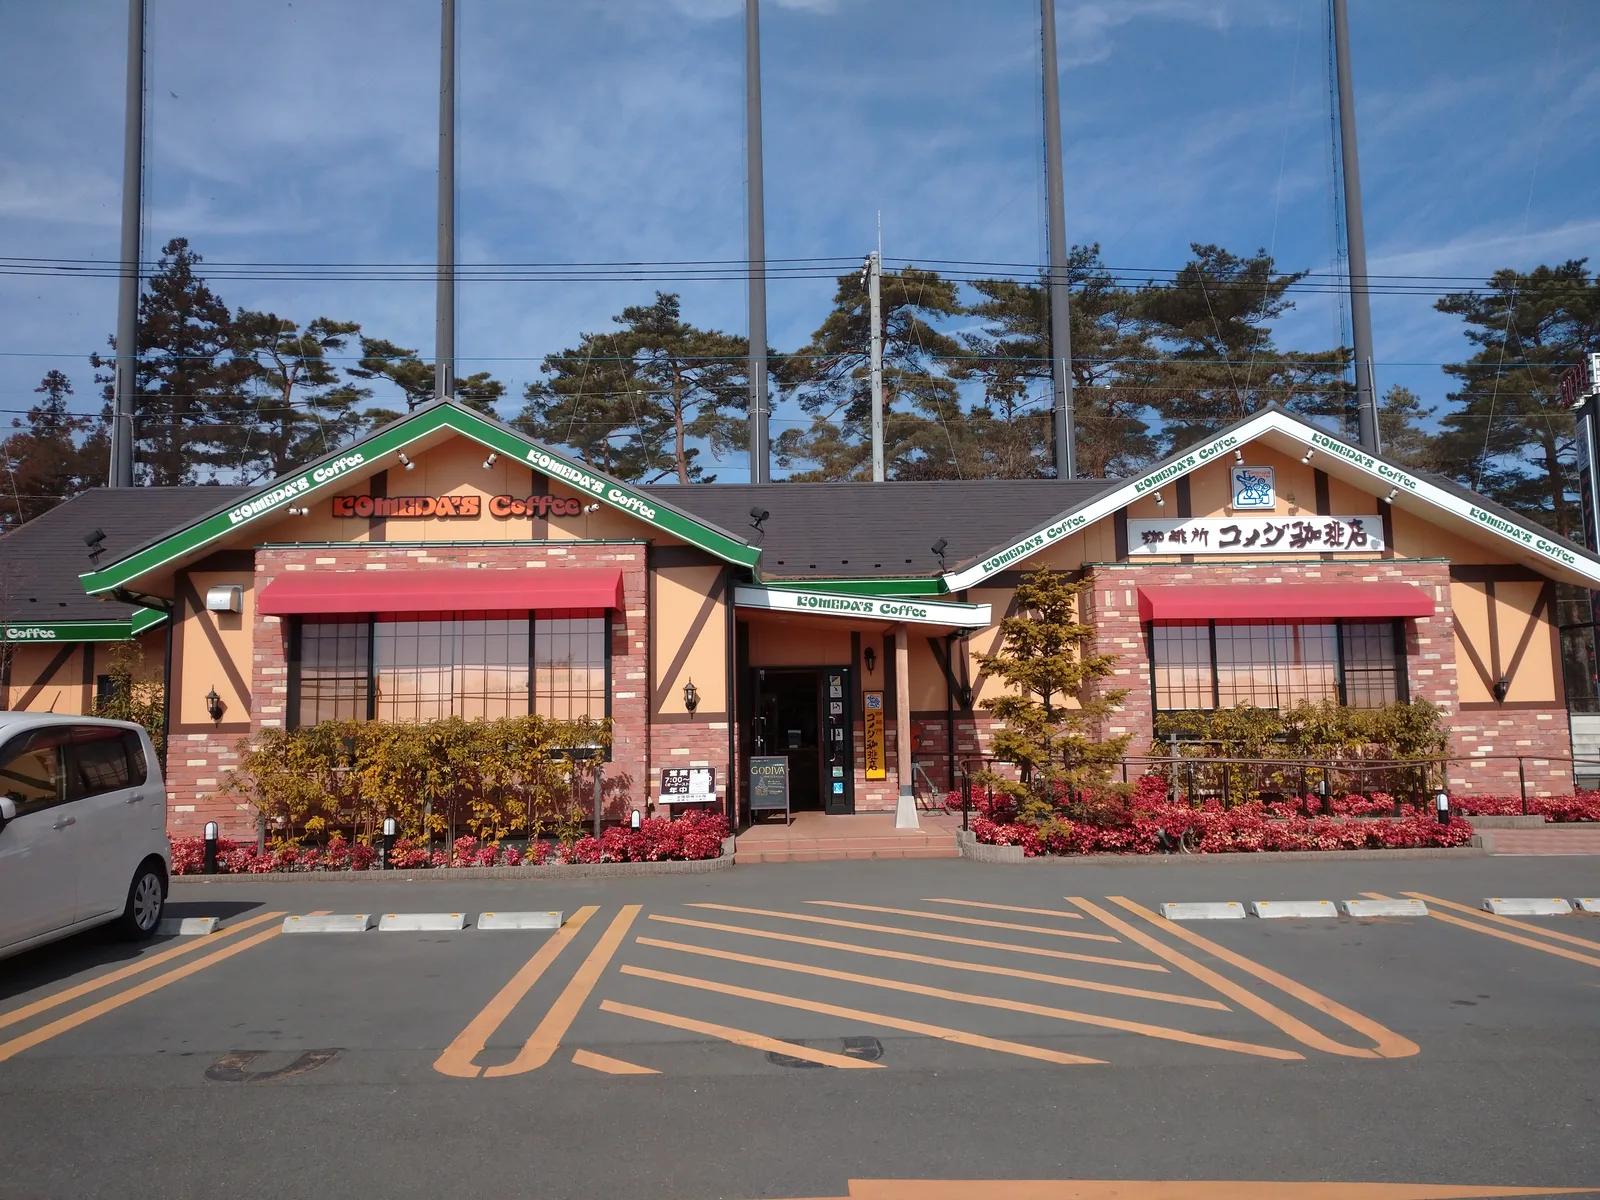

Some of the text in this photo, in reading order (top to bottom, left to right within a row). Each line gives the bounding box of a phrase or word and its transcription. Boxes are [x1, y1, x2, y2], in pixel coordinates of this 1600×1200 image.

[228, 452, 364, 525] KOMEDA'S Coffee
[526, 449, 656, 520] KOMEDA'S Coffee
[1134, 436, 1238, 493] KOMEDA'S Coffee
[1311, 432, 1417, 490] KOMEDA'S Coffee
[332, 494, 581, 519] KOMEDA'S Coffee
[1219, 518, 1368, 550] コメダ珈琲店
[982, 515, 1086, 573] KOMEDA'S Coffee
[1469, 507, 1576, 565] KOMEDA'S Coffee
[6, 628, 56, 639] Coffee
[796, 595, 927, 618] KOMEDA'S Coffee
[750, 766, 785, 775] GODIVA
